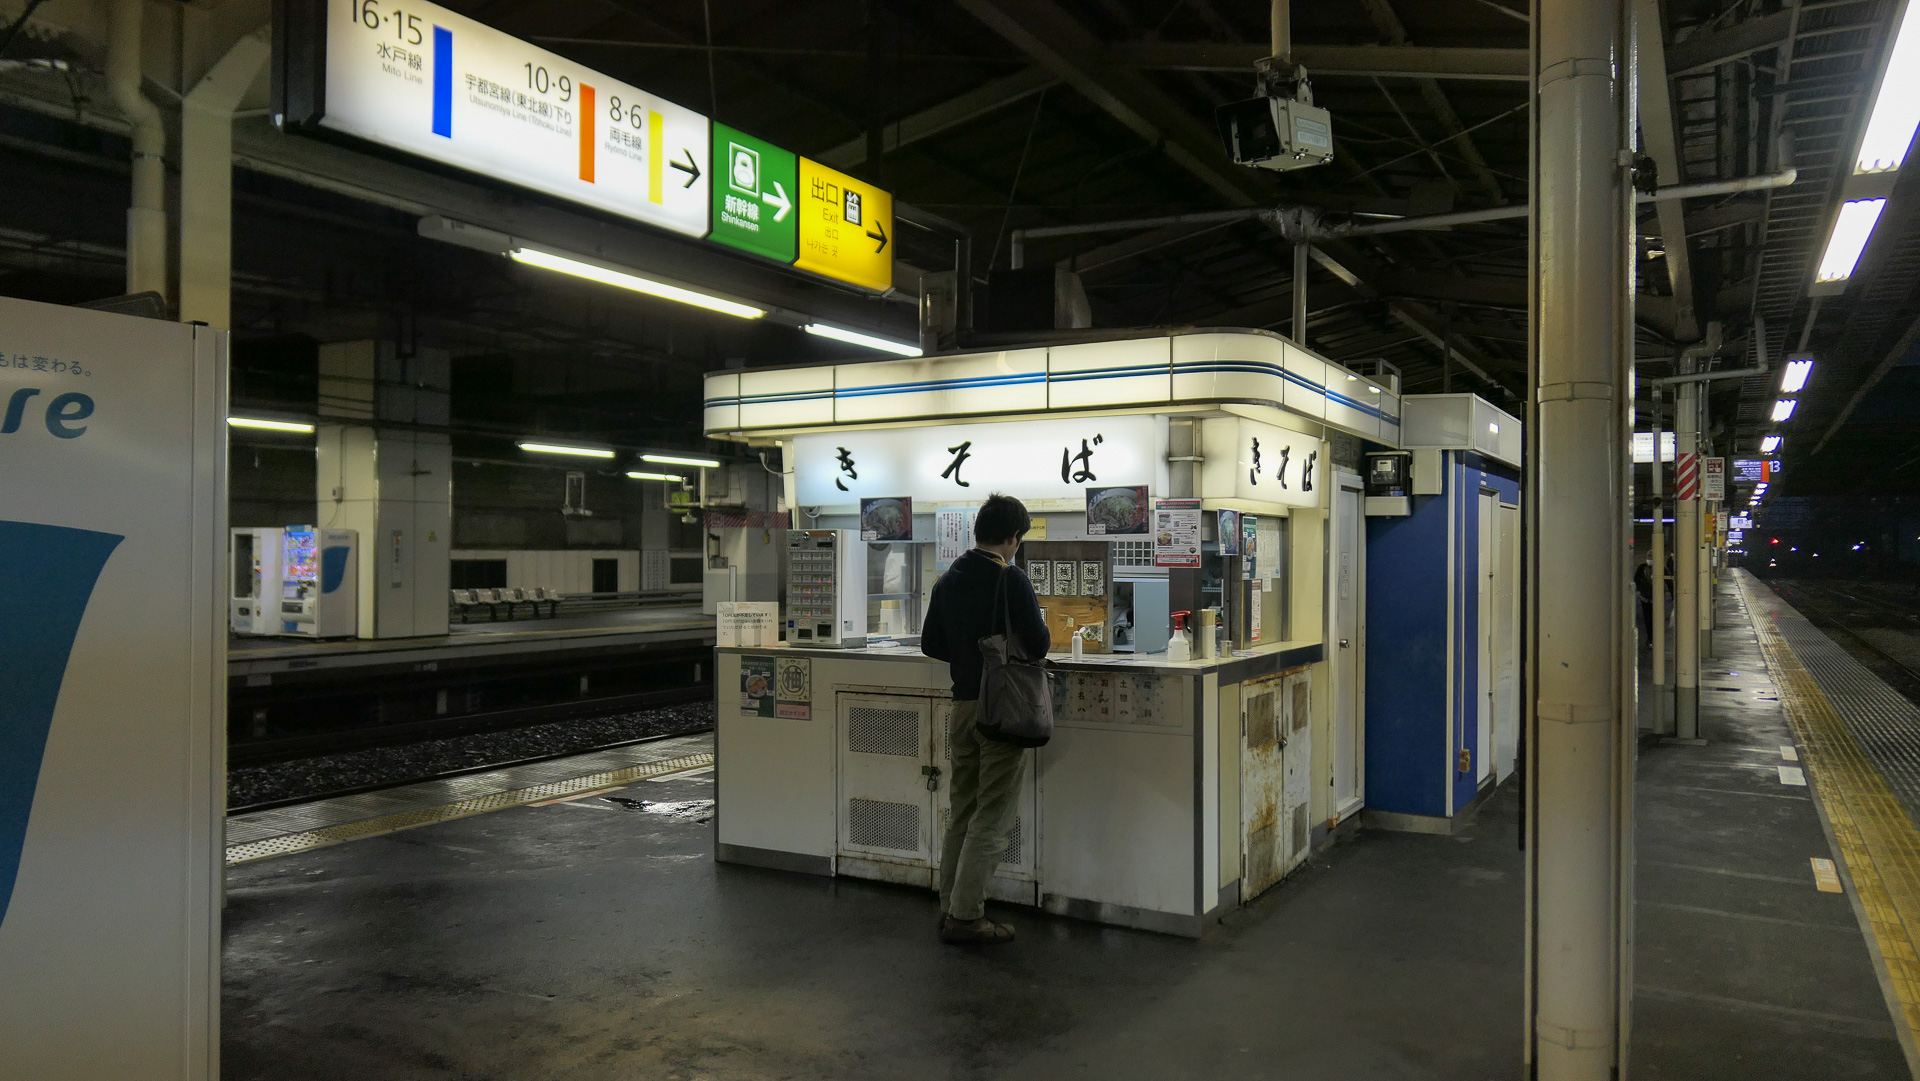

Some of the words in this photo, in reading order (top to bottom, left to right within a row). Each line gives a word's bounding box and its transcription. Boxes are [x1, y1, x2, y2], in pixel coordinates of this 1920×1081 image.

[377, 42, 422, 71] 水戸線
[382, 63, 402, 79] Mito
[404, 69, 423, 85] Line
[470, 94, 511, 116] Utsunomiya
[609, 126, 642, 150] 両毛線
[811, 176, 838, 206] 出口
[725, 193, 759, 221] 新幹線
[822, 208, 838, 224] Exit
[721, 211, 759, 232] Shinkansen
[834, 433, 1104, 492] きそば
[1249, 436, 1317, 492] きそば
[1768, 460, 1781, 473] 13
